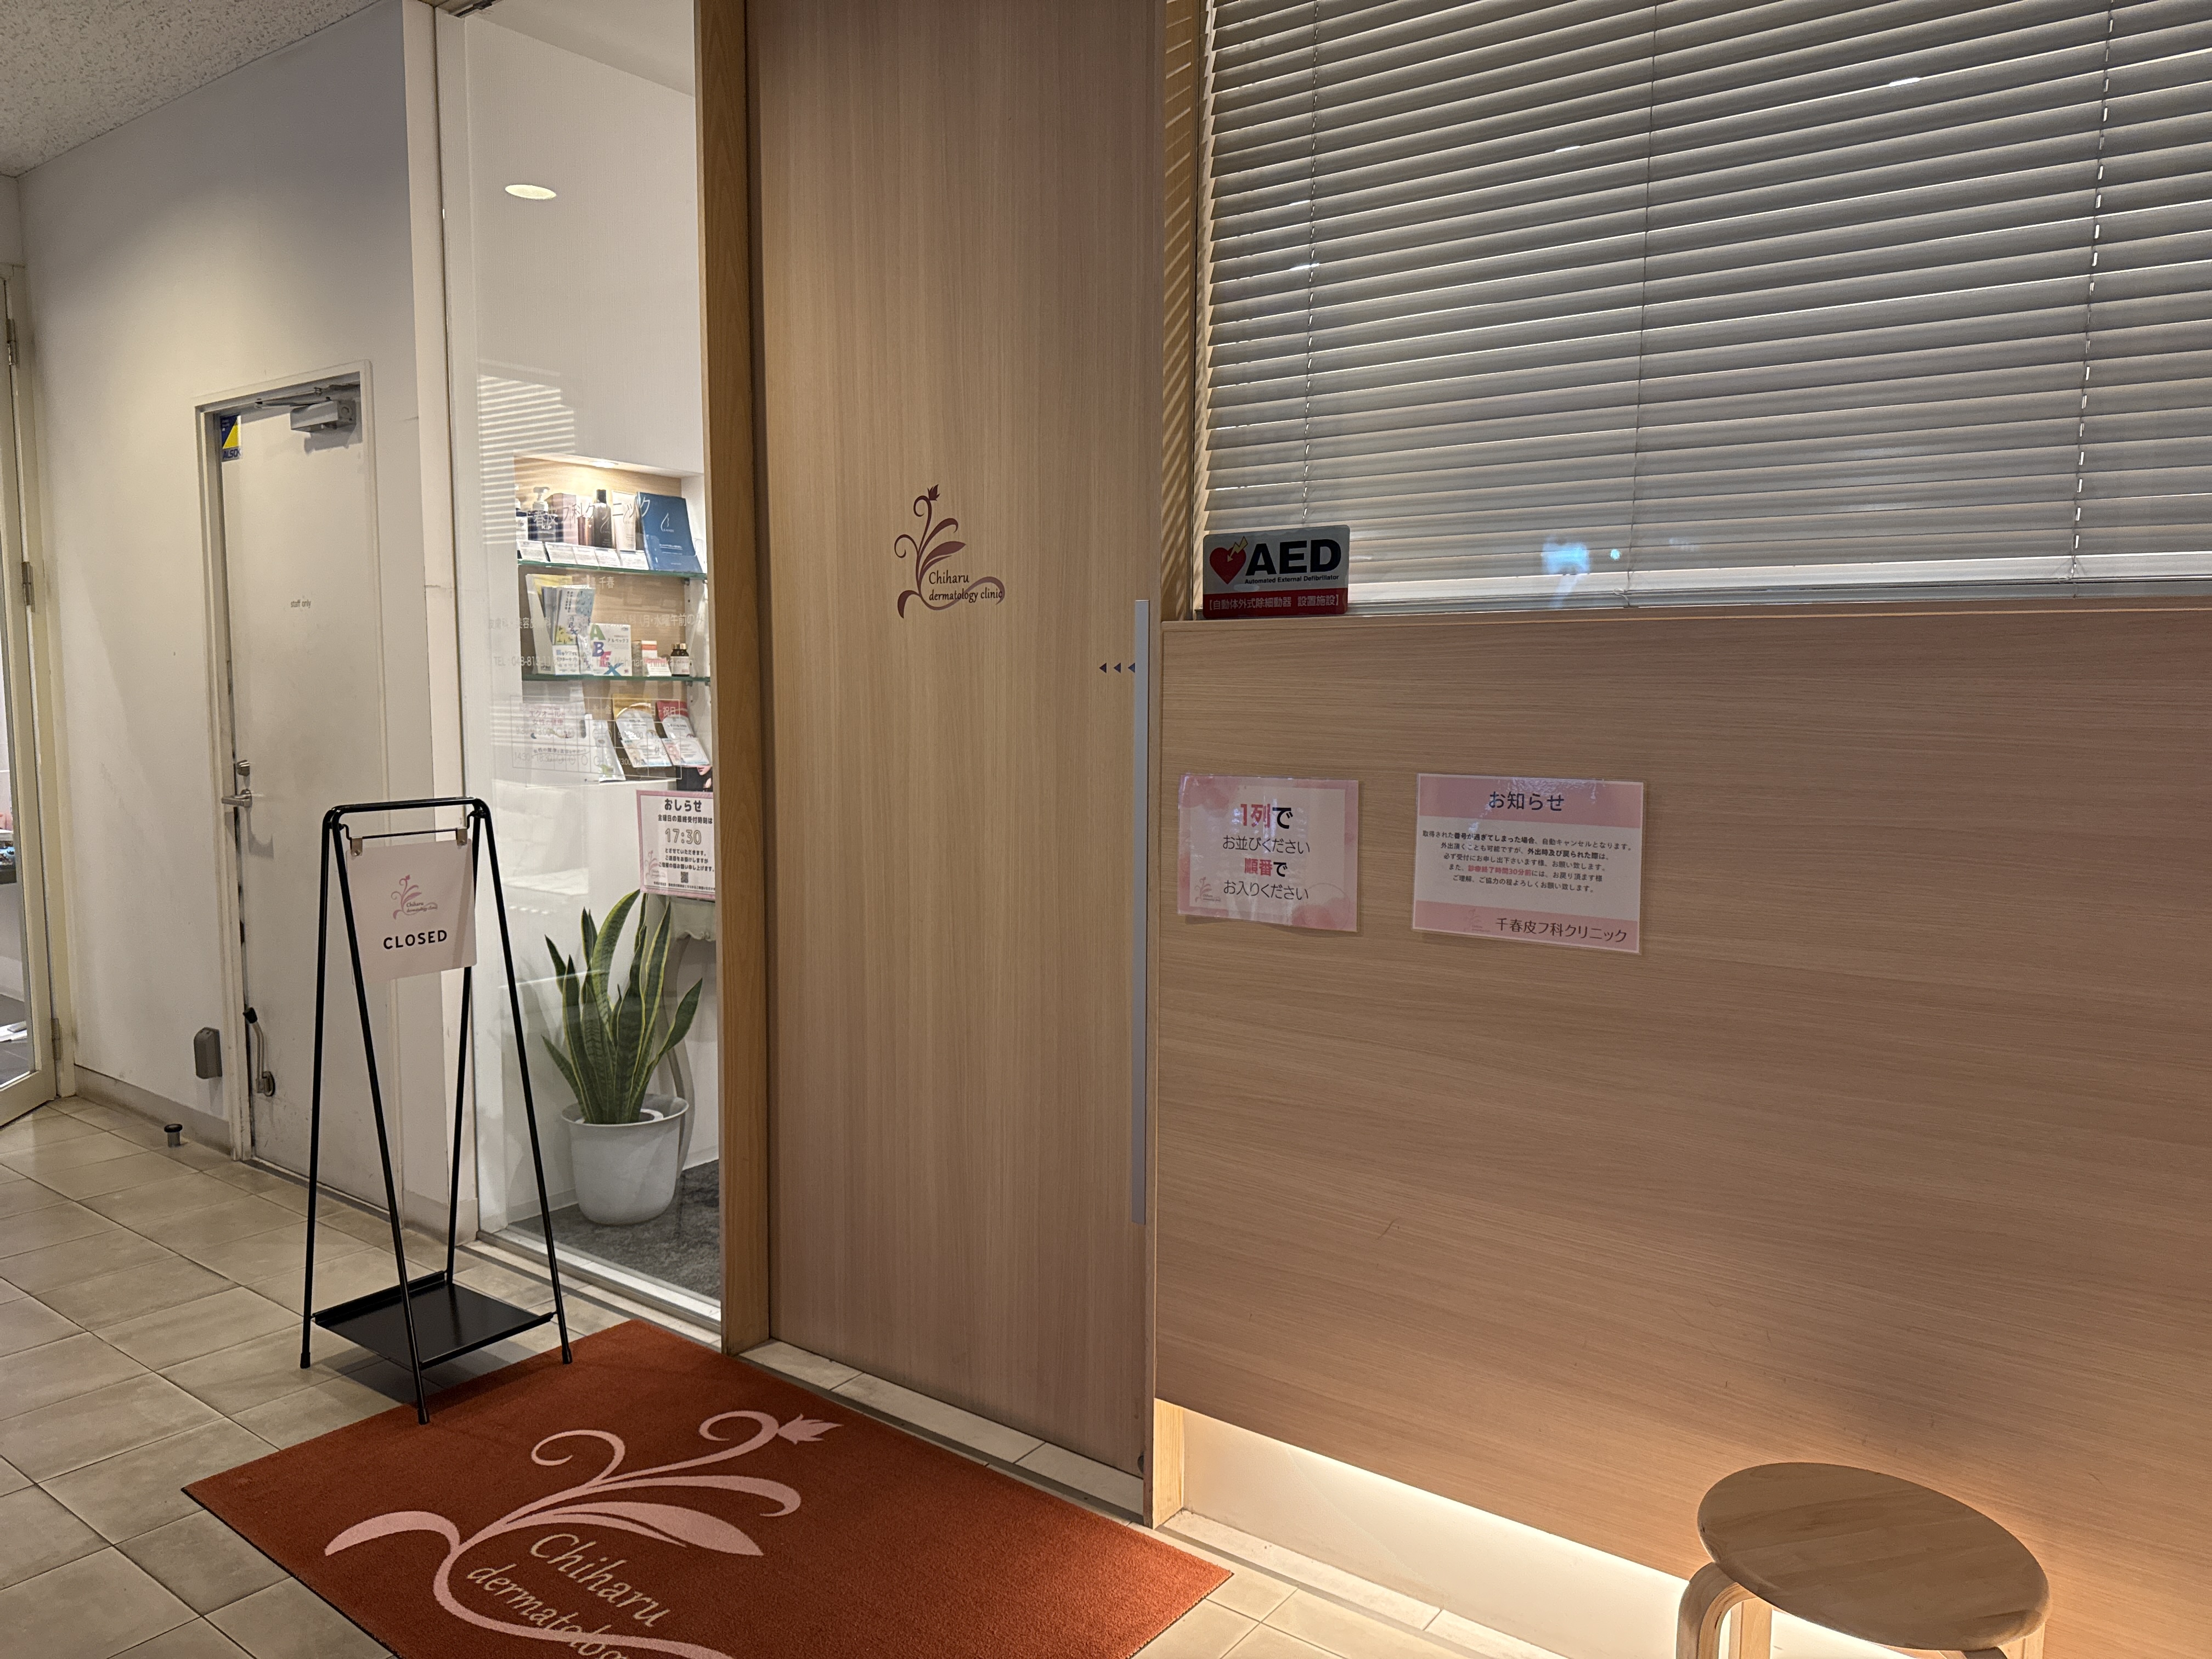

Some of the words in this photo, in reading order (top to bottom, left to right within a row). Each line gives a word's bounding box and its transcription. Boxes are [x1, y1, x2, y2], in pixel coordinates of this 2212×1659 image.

[223, 449, 241, 459] ALSOK
[1245, 539, 1342, 576] AED
[929, 569, 969, 584] Chiharu
[929, 588, 978, 603] dermatology
[980, 587, 1002, 599] clinic
[664, 798, 702, 812] おしらせ
[1489, 791, 1565, 811] お知らせ
[658, 814, 713, 825] 金曜日の最終受付時刻は
[1240, 803, 1293, 829] 1列で
[665, 828, 702, 845] 17:30
[1222, 835, 1310, 854] お並びください
[1244, 857, 1288, 877] 順番で
[1223, 880, 1308, 900] お入りください
[383, 929, 448, 950] CLOSED
[1496, 918, 1627, 943] 千春皮フ科クリニック
[531, 1533, 670, 1628] Chiharu
